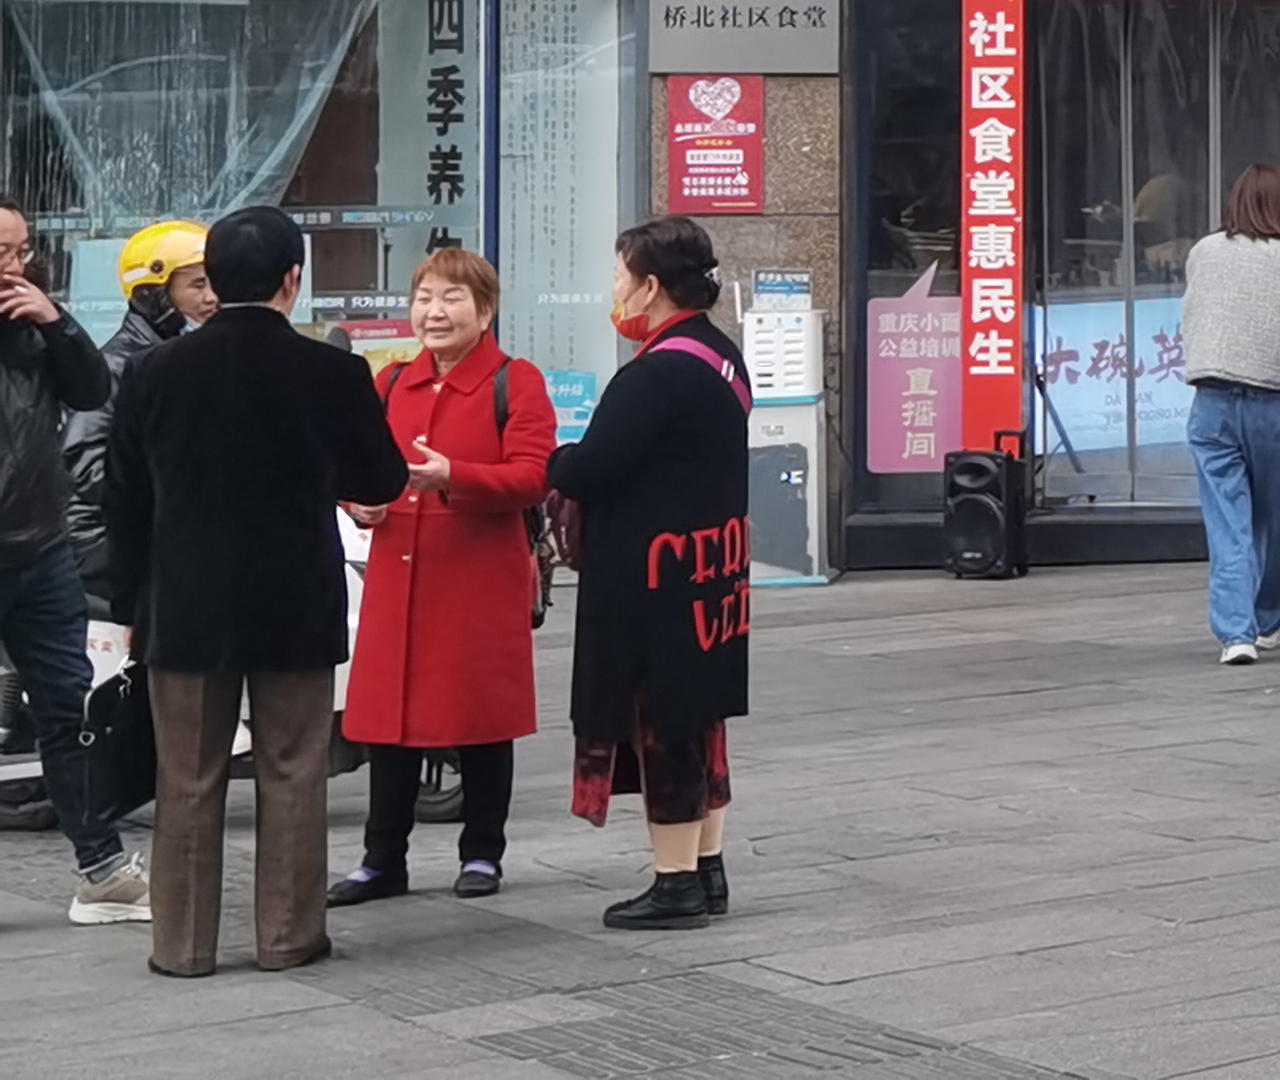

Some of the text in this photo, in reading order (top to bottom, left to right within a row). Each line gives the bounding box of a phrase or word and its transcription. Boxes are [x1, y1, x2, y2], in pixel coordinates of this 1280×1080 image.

[663, 5, 829, 30] 桥北社区食堂
[968, 11, 1017, 376] 社区食堂惠民生
[878, 337, 962, 359] 公益培训
[901, 367, 938, 460] 直播间
